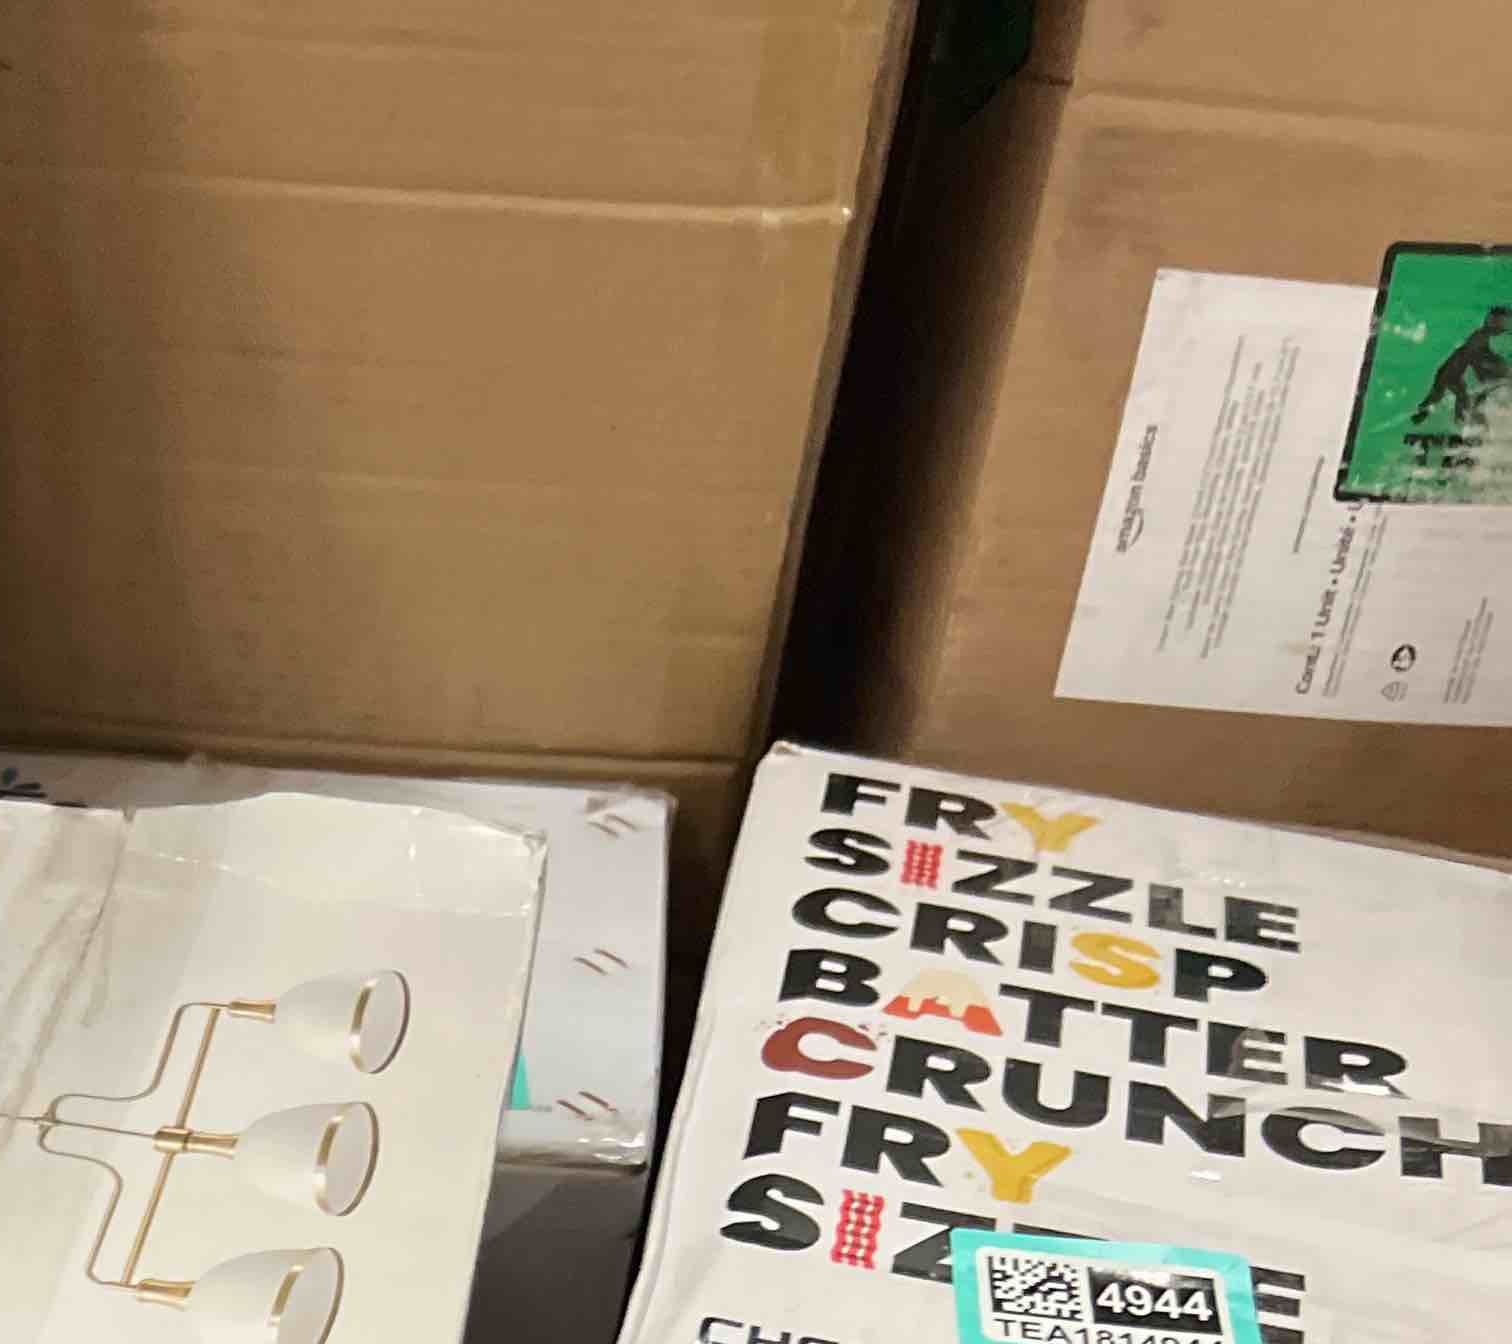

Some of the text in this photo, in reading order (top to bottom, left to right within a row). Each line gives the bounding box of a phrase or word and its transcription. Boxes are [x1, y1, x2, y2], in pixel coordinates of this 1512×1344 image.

[1116, 424, 1159, 553] amazon basics
[820, 772, 1099, 853] FRY
[792, 887, 1270, 1003] CRISP
[804, 827, 1301, 953] SIZZLE
[778, 947, 1410, 1100] BATTER
[743, 1091, 1073, 1205] FRY
[760, 1015, 1512, 1188] CRUNCH
[1096, 1281, 1213, 1322] 4944
